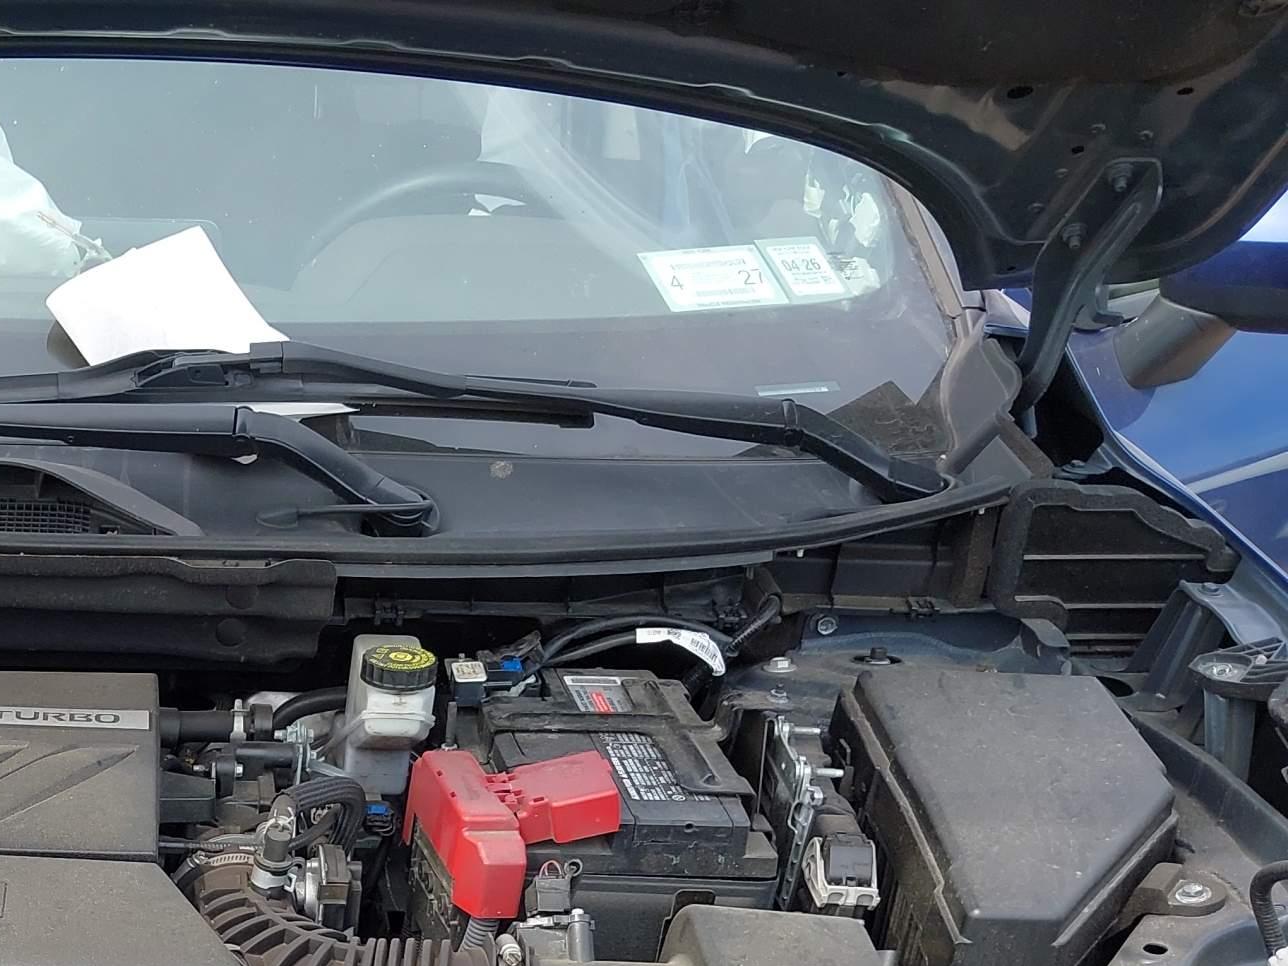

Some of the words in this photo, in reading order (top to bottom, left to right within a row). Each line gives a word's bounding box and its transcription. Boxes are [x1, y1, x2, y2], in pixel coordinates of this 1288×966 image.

[781, 259, 800, 272] 04
[801, 257, 821, 271] 26
[671, 274, 684, 291] 4
[737, 269, 764, 285] 27
